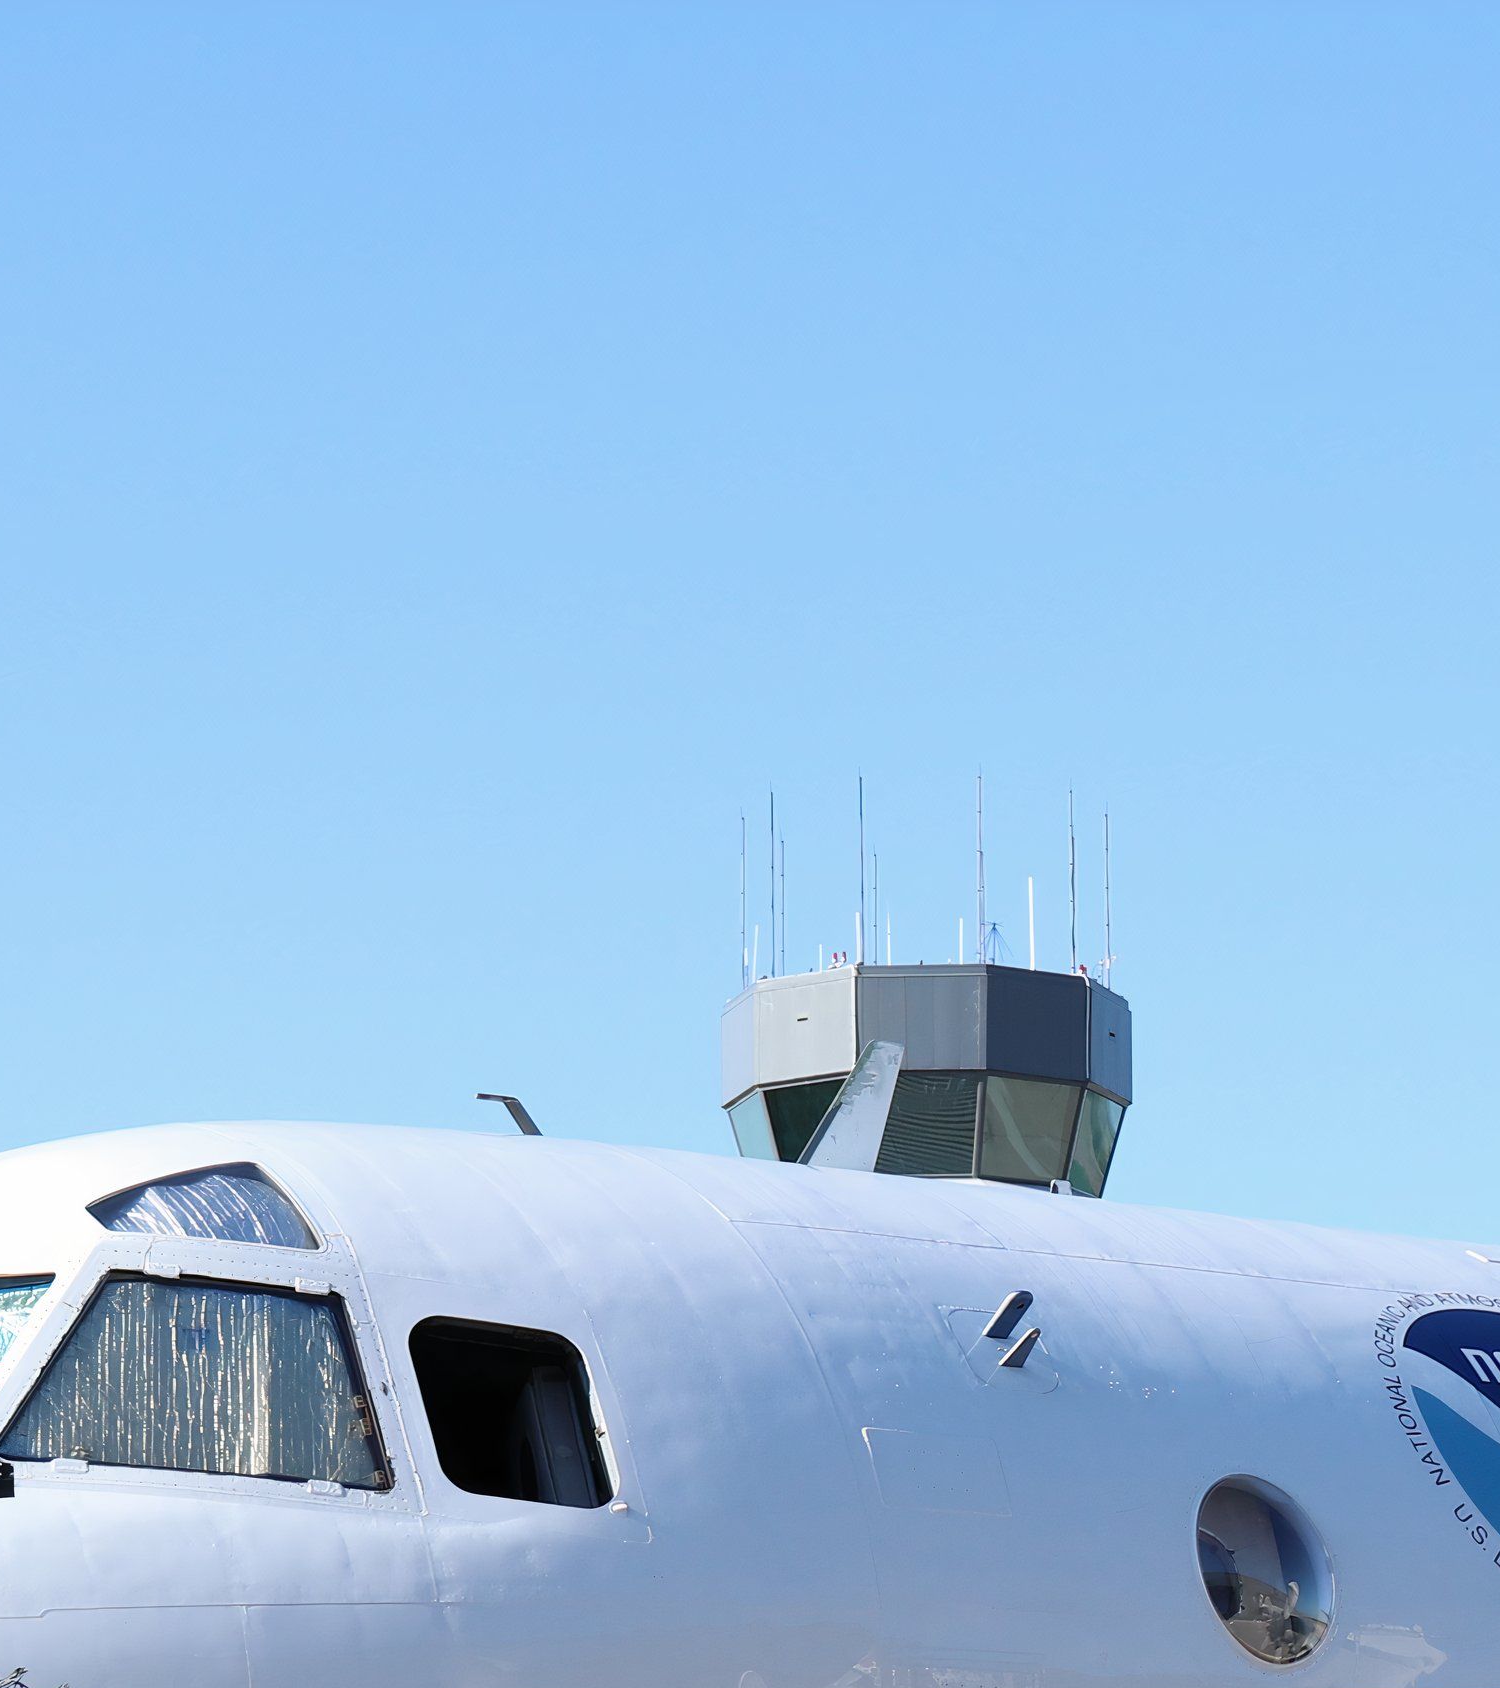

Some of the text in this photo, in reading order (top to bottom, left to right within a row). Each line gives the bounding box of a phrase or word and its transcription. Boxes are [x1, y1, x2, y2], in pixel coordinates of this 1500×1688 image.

[1397, 1293, 1434, 1316] AND
[1373, 1305, 1408, 1369] OCEANIC
[1385, 1373, 1450, 1486] NATIONAL
[1453, 1503, 1489, 1552] U.S.
